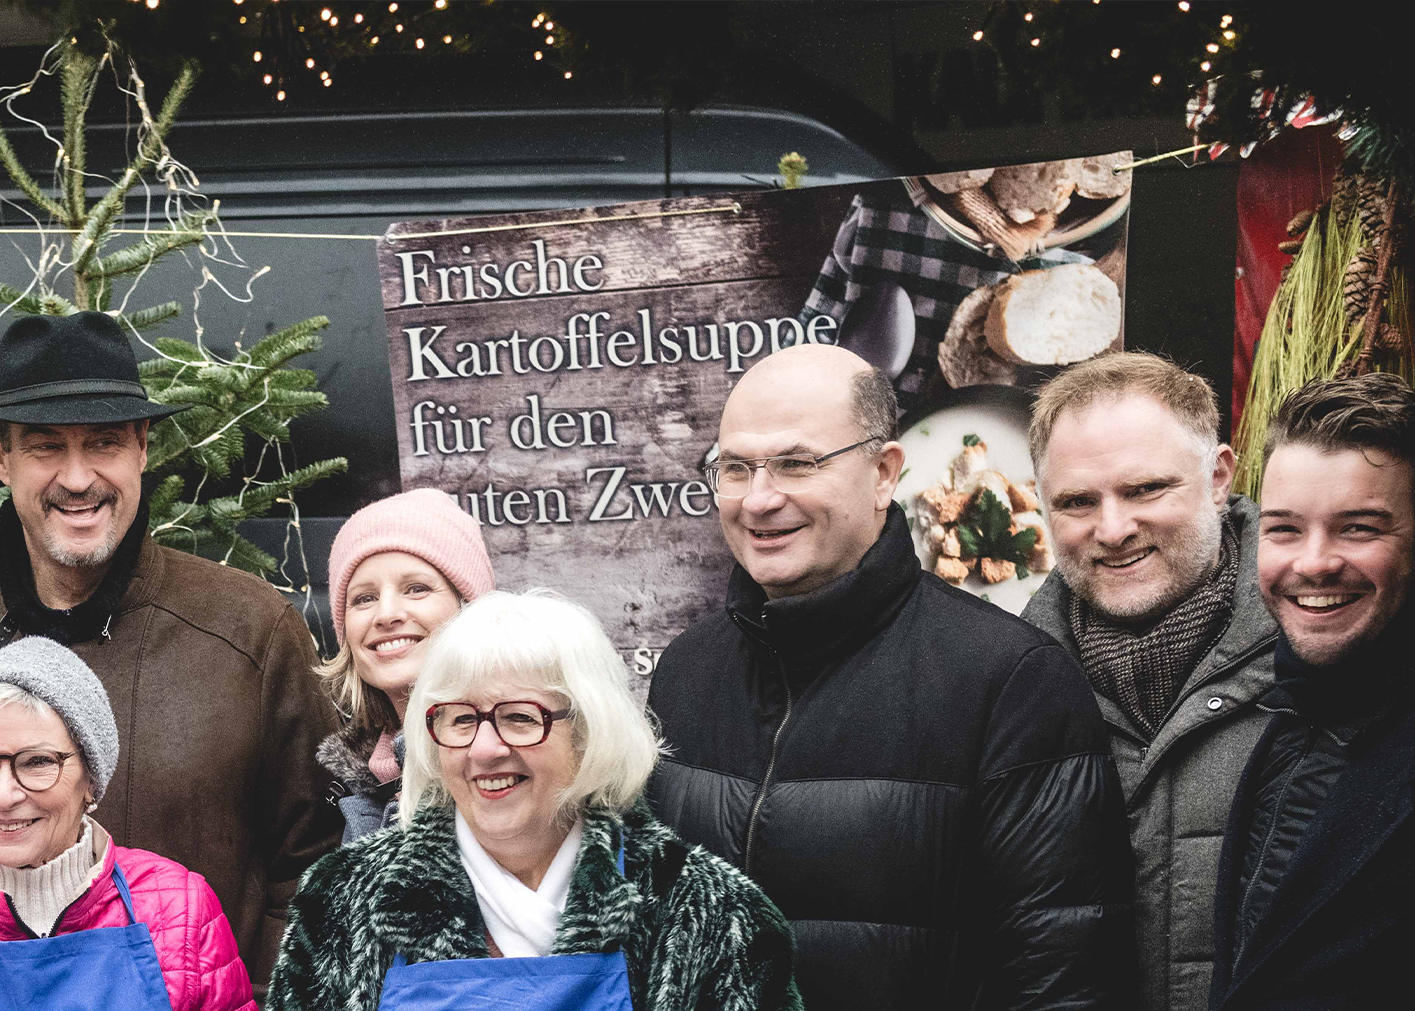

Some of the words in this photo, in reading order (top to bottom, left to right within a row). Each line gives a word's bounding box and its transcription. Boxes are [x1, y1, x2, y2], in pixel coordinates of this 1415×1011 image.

[395, 239, 605, 306] Frische
[402, 308, 839, 382] Kartoffelsuppe
[410, 400, 492, 457] für
[510, 395, 618, 452] den
[449, 482, 573, 527] uten
[586, 466, 720, 523] Zwe
